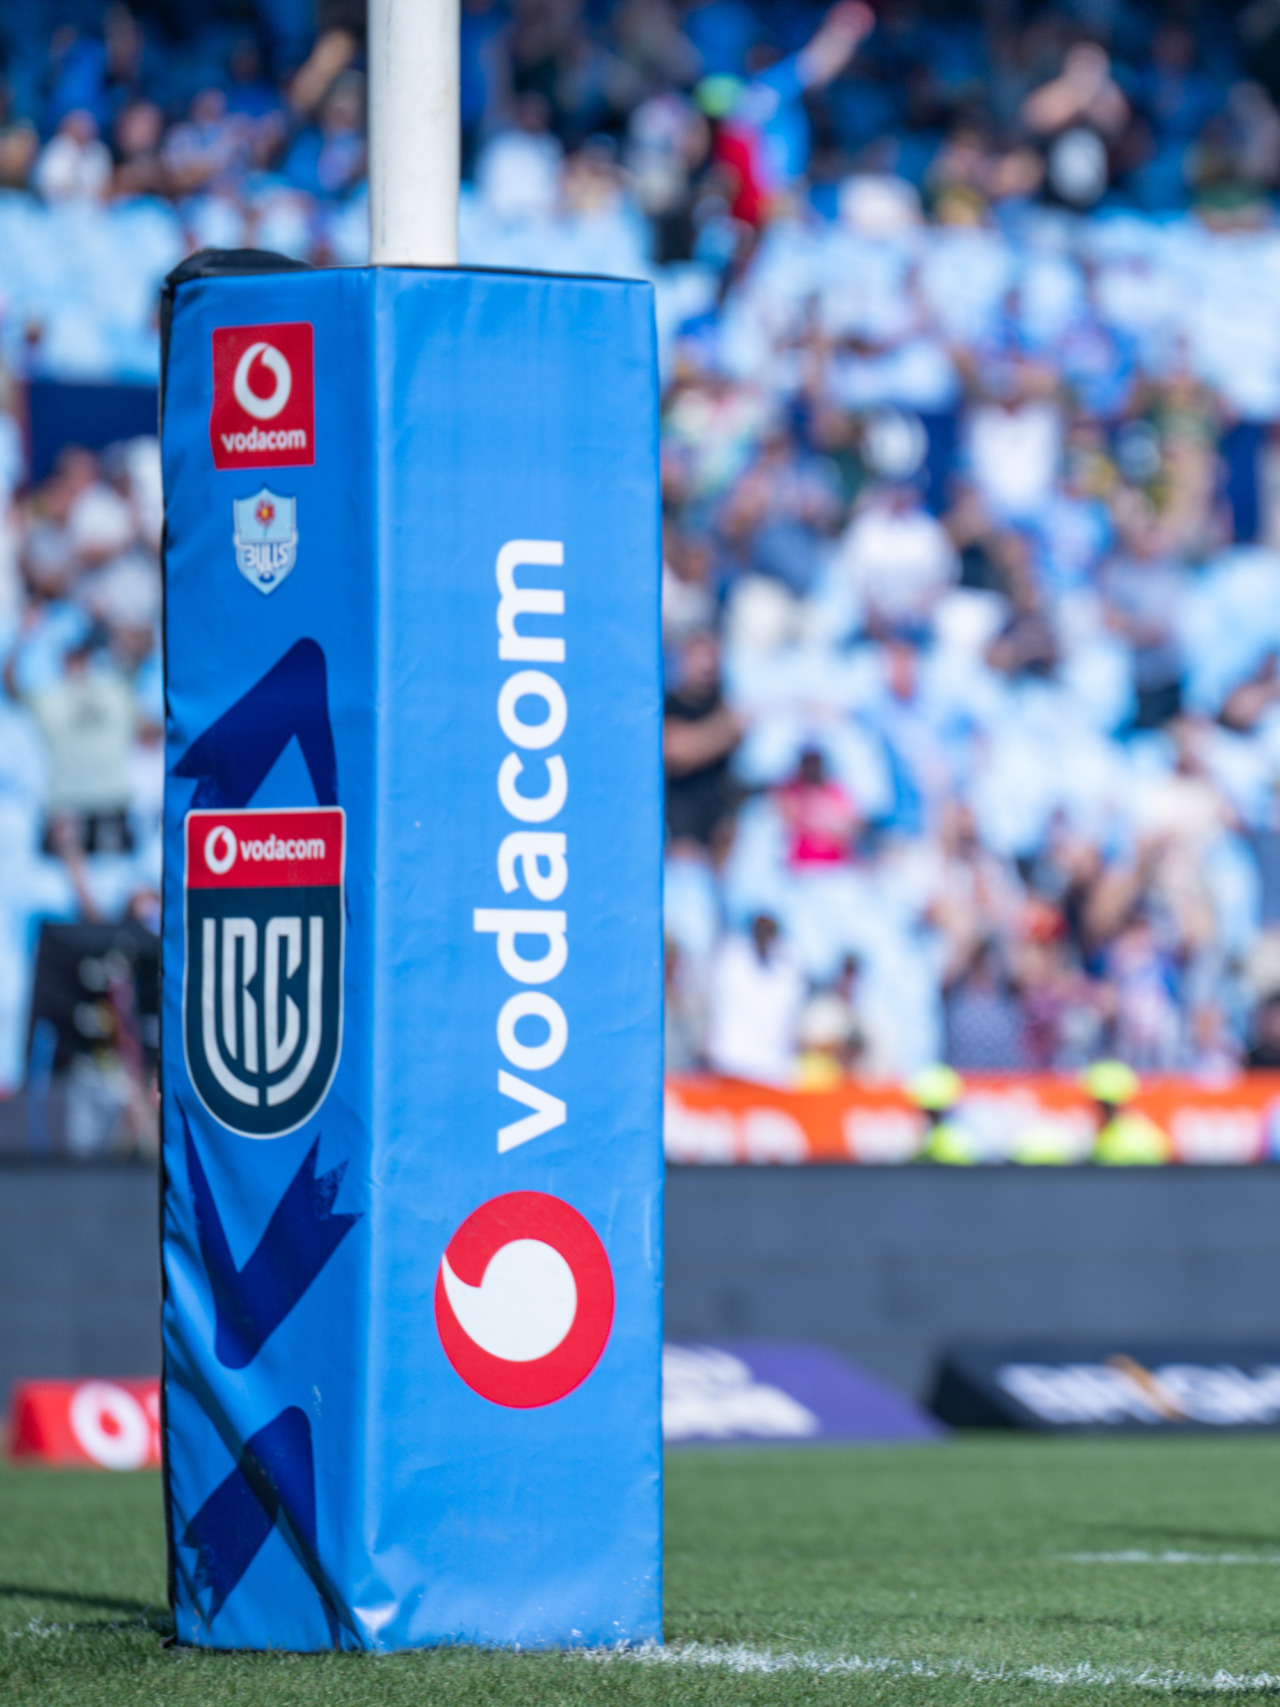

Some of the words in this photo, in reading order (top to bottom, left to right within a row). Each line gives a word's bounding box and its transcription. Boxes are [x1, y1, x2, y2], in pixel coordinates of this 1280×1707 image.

[220, 425, 307, 453] vodacom
[240, 834, 326, 861] vodacom
[473, 538, 569, 1156] vodacom
